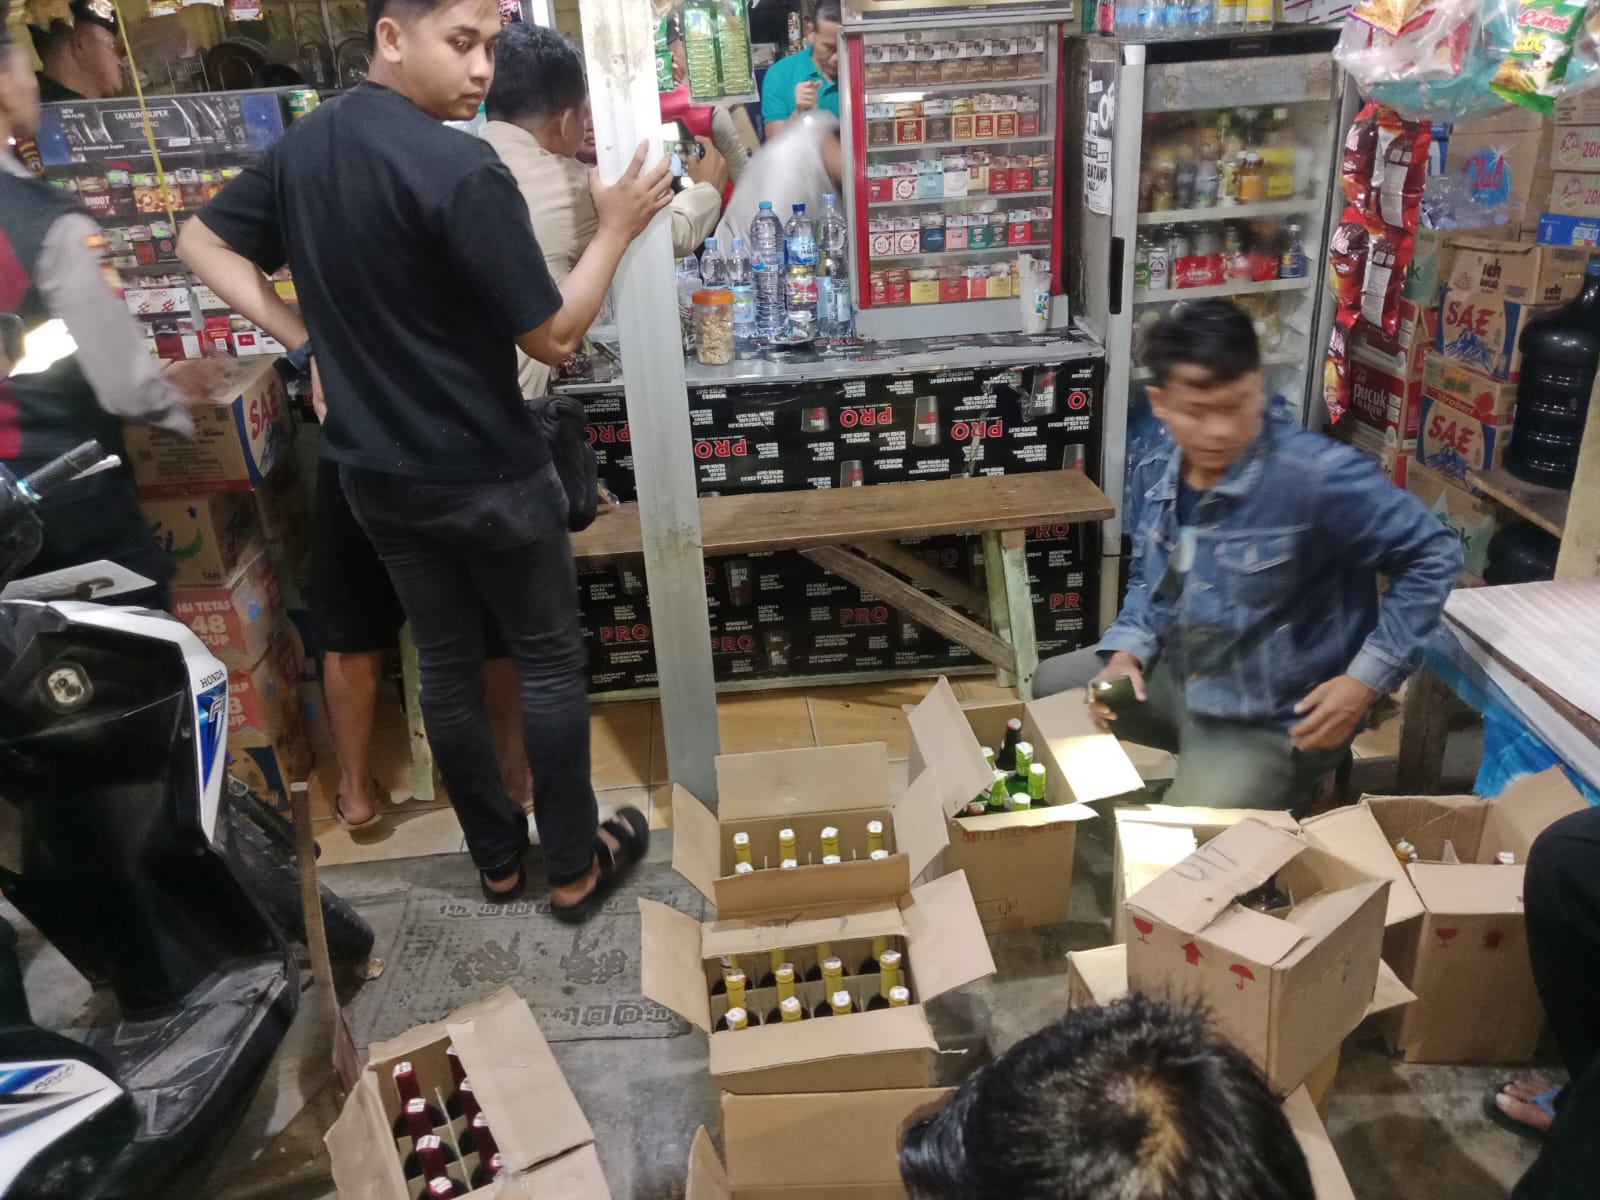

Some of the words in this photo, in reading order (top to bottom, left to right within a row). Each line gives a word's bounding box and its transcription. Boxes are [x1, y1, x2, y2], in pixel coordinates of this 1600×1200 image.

[1446, 300, 1497, 336] SAE
[1353, 383, 1387, 411] pucuk
[839, 407, 892, 427] PRO
[951, 419, 1003, 441] PRO
[1427, 415, 1476, 454] SAE
[694, 439, 747, 458] PRO
[1050, 593, 1080, 609] PR
[192, 614, 227, 634] 48
[840, 607, 887, 623] PRO
[600, 624, 649, 643] PRO
[200, 670, 225, 688] HONDA
